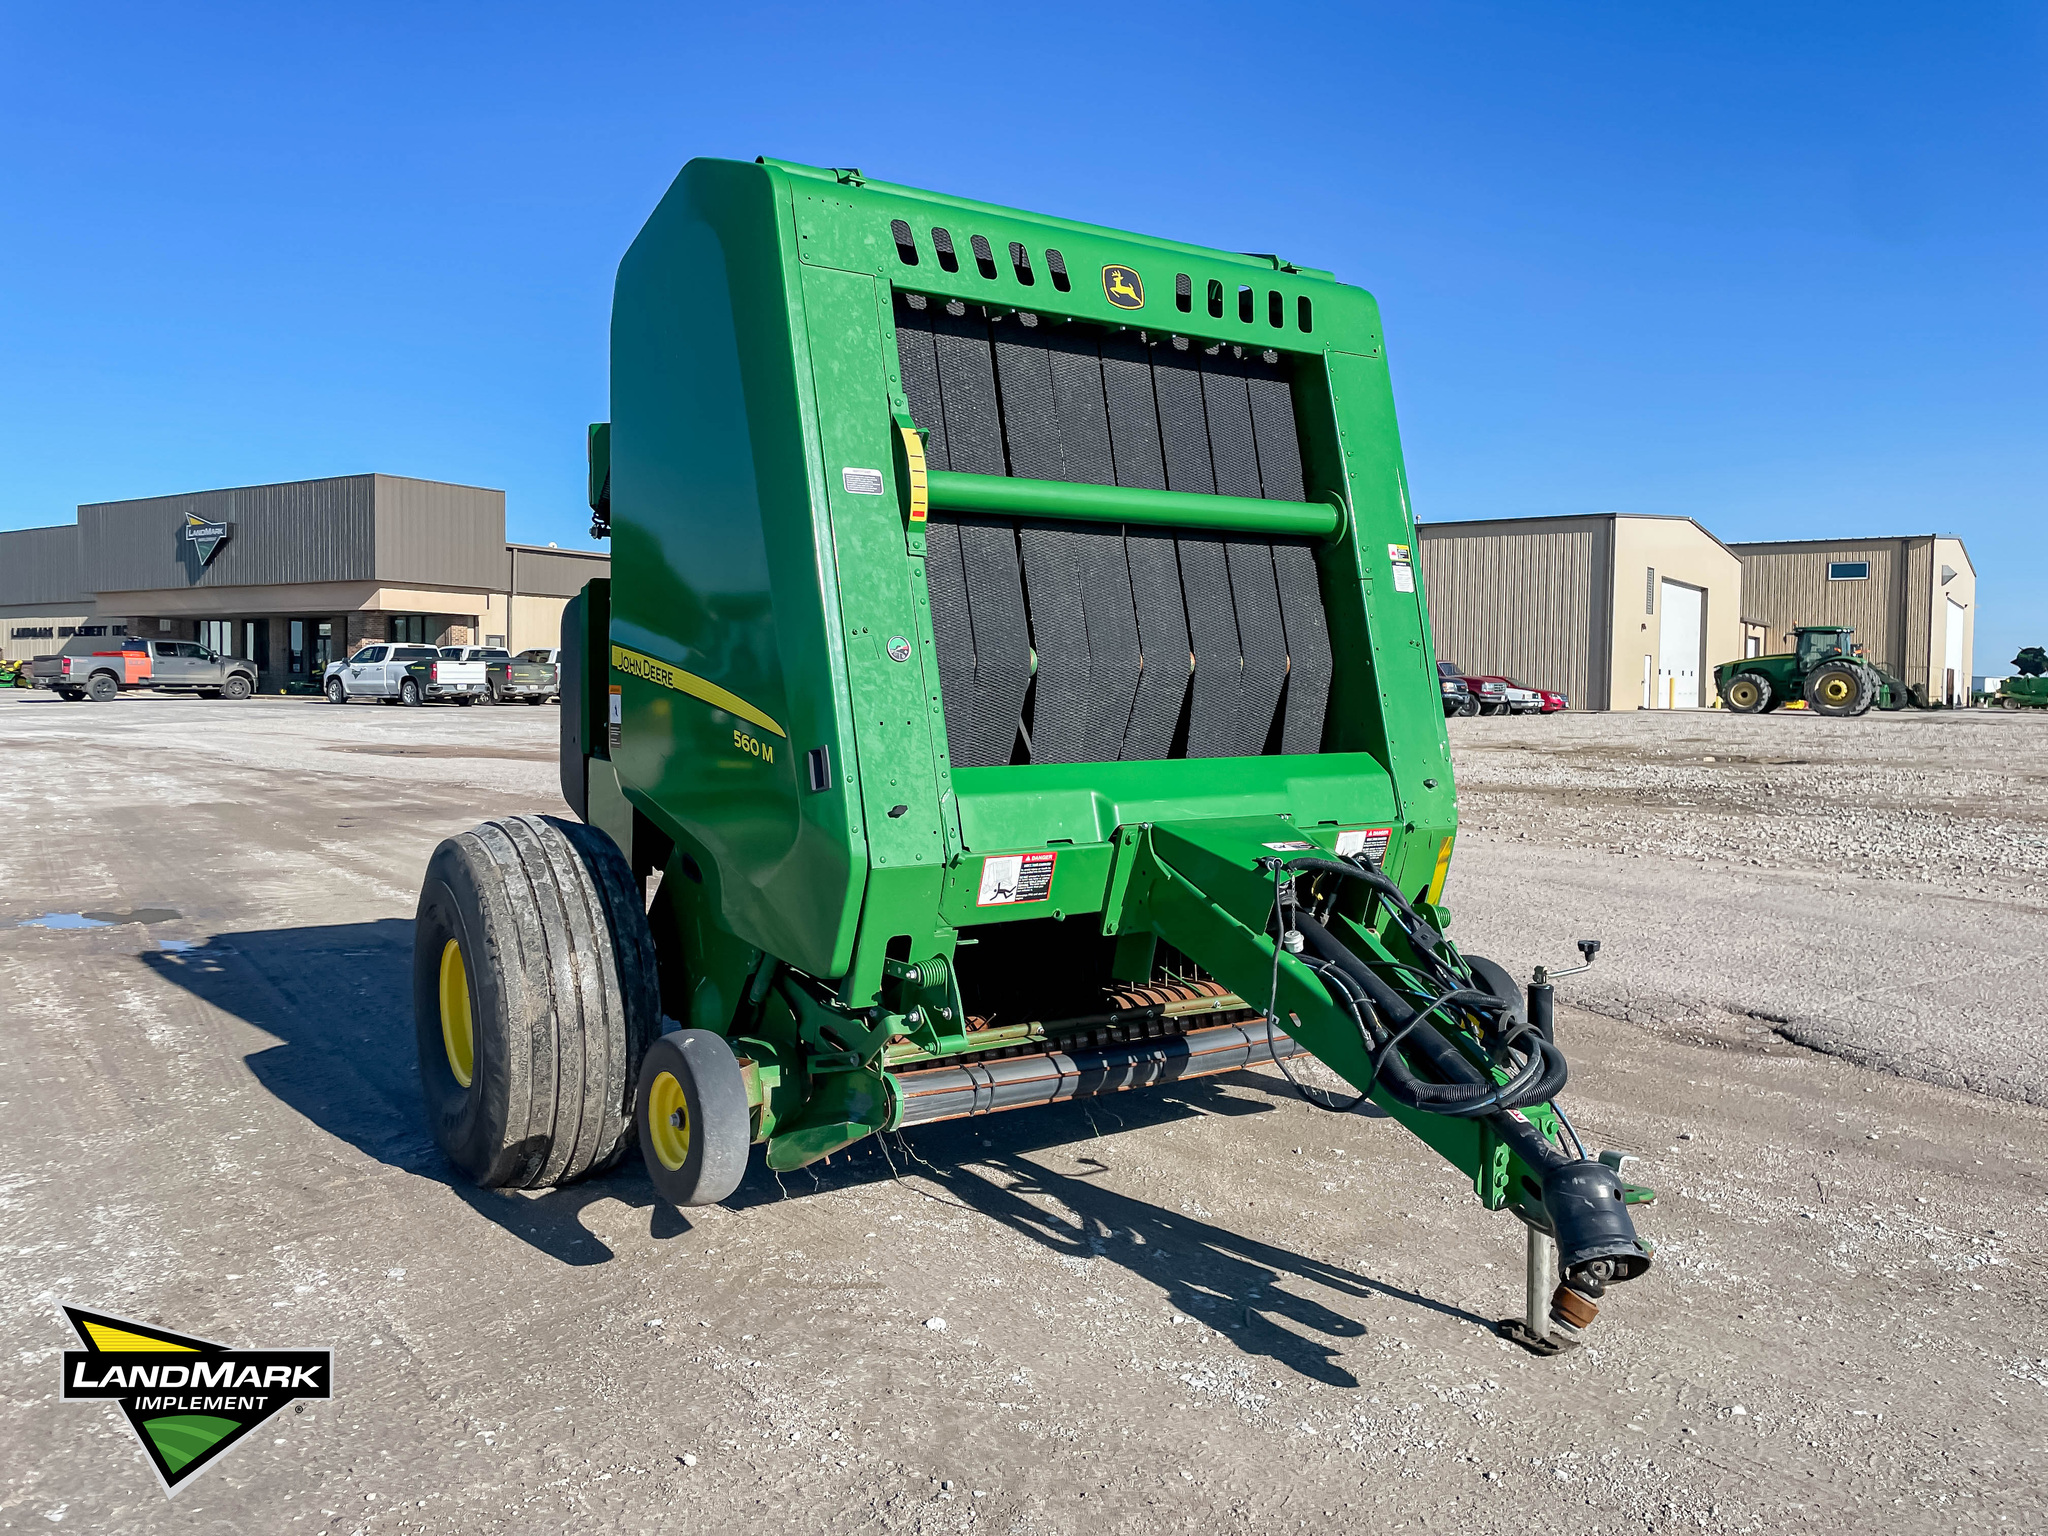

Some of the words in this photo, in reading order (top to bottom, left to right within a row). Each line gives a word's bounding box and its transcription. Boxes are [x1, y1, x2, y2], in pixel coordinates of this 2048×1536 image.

[618, 651, 642, 677] JOHN
[643, 659, 674, 687] DEERE
[733, 729, 760, 757] 560
[761, 742, 774, 765] M
[1031, 854, 1053, 862] DANGER
